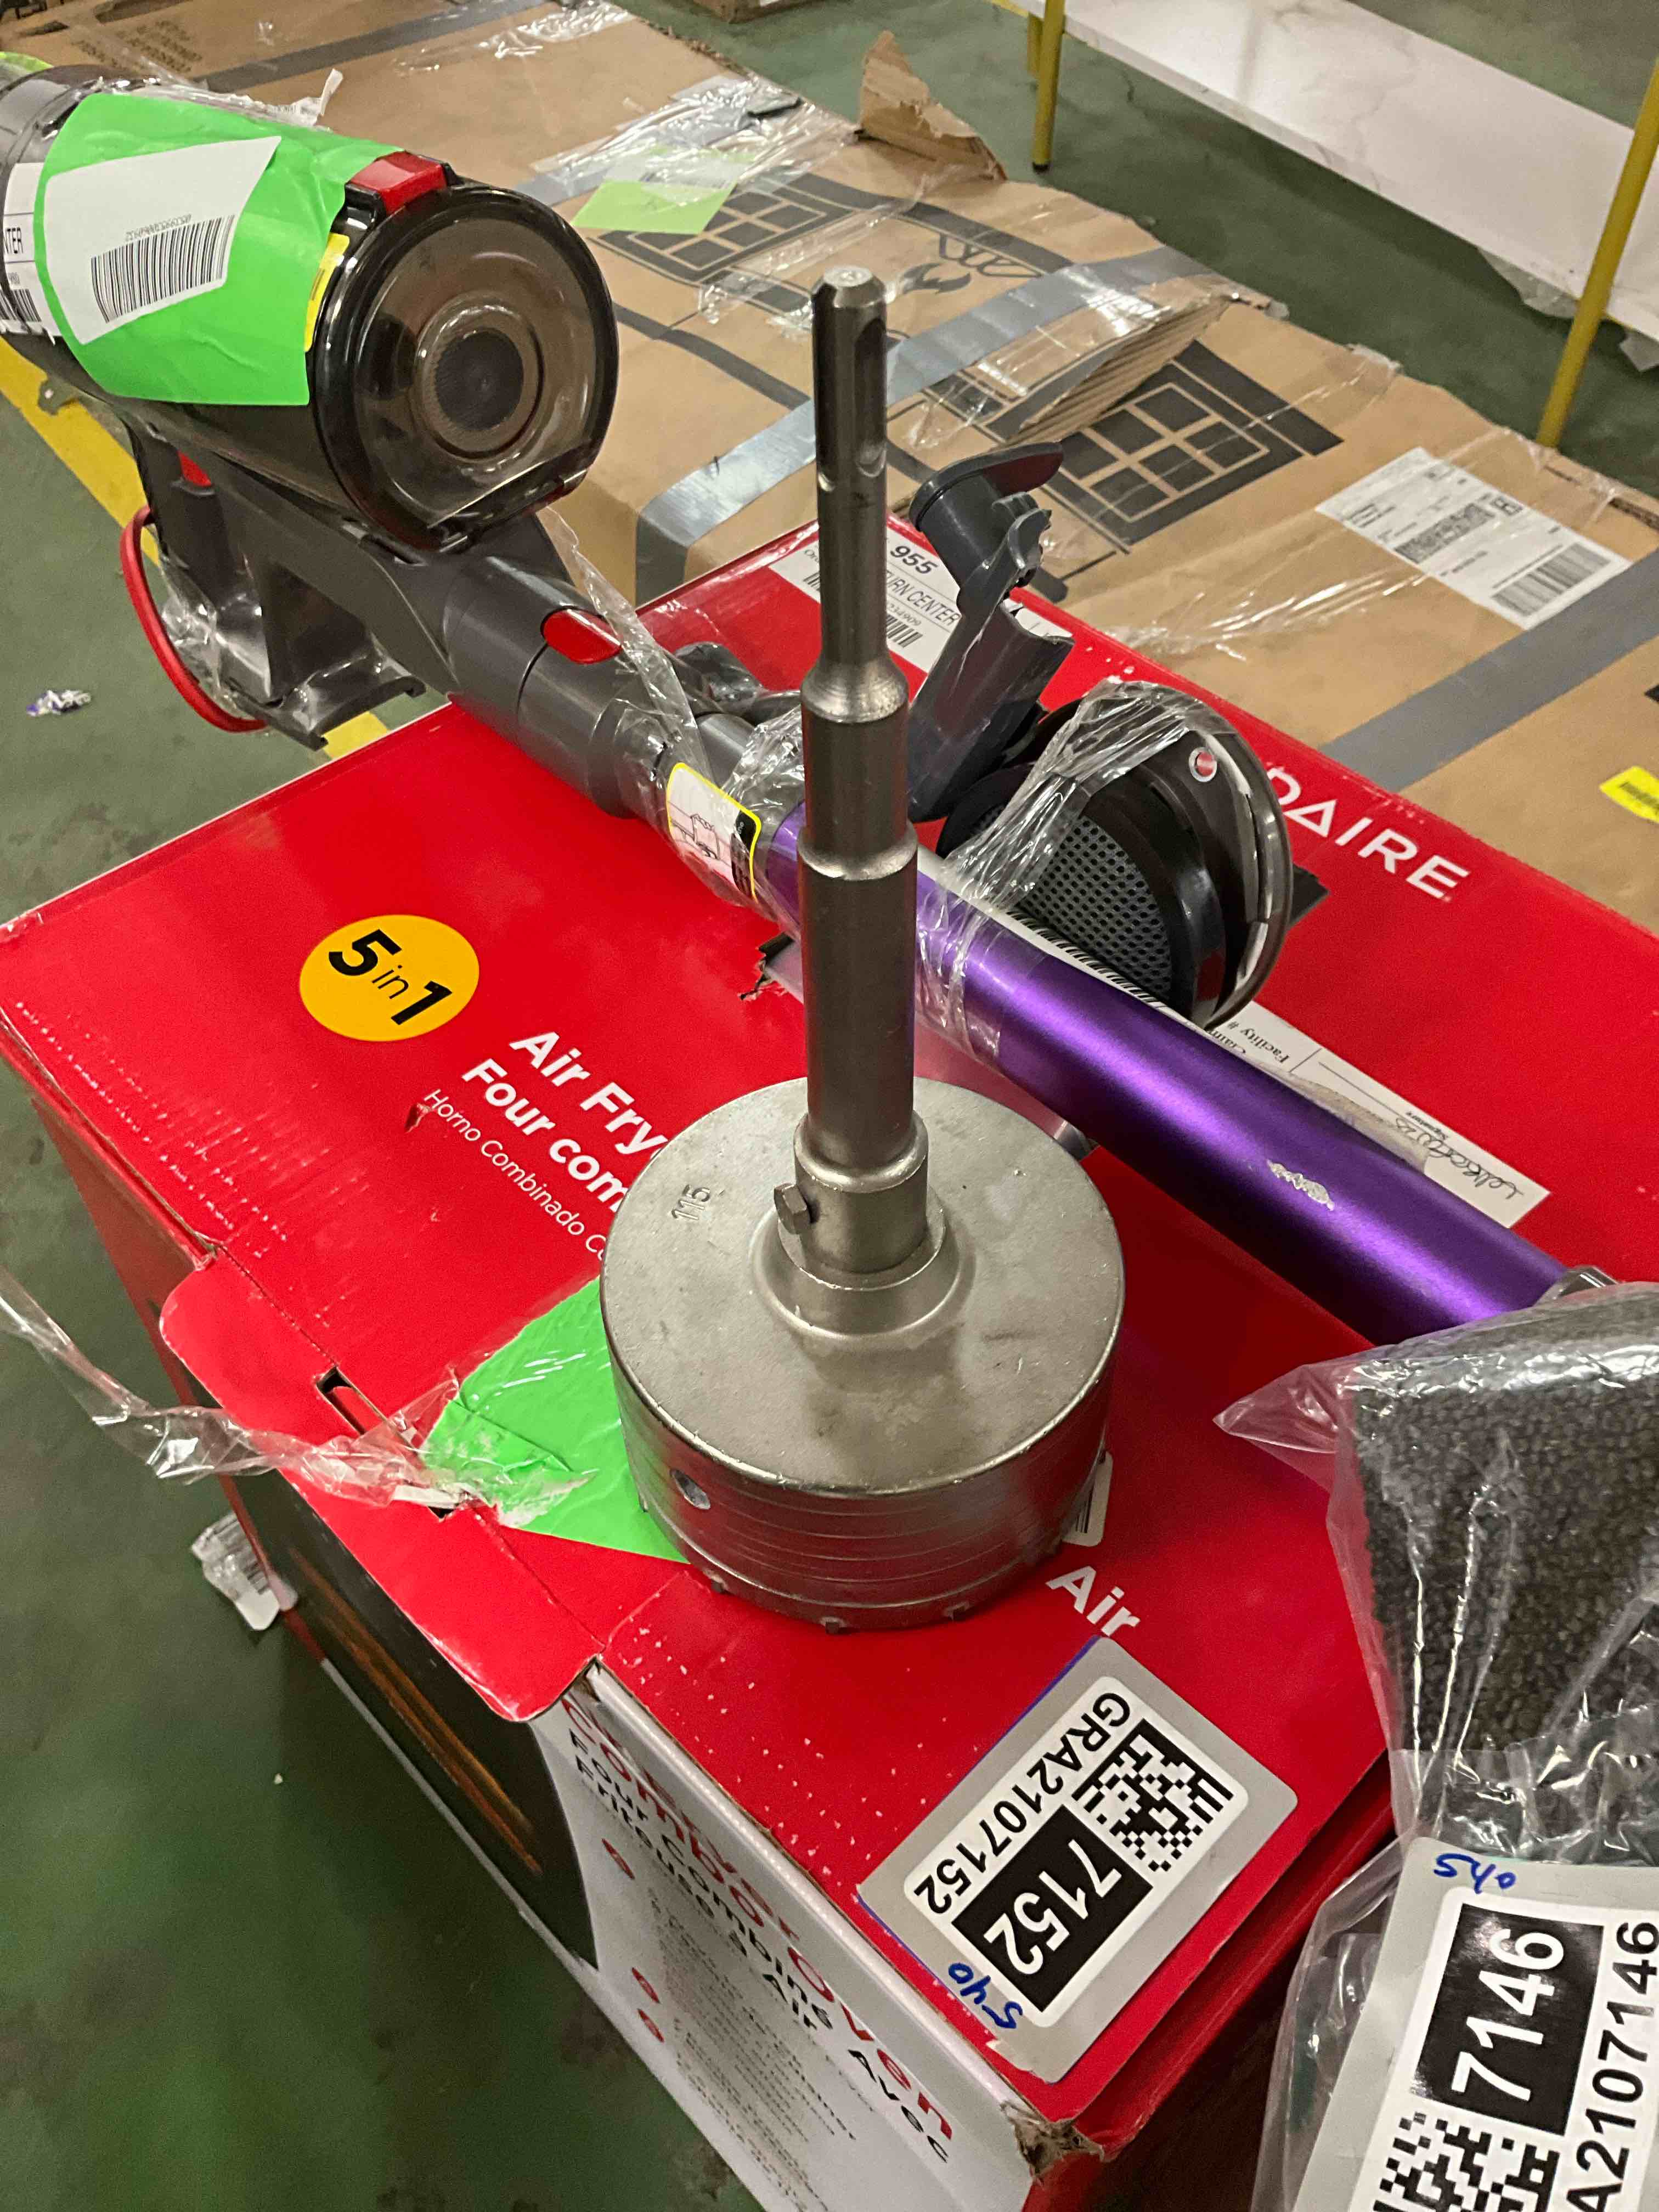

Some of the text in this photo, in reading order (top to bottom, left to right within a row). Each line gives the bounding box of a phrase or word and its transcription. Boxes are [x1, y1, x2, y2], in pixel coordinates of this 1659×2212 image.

[890, 545, 938, 574] 955
[907, 590, 961, 627] CENTER
[328, 929, 453, 1025] 5 in 1
[509, 1031, 590, 1087] Air
[1240, 1028, 1289, 1063] Facility
[461, 1058, 556, 1136] Four
[422, 1088, 481, 1142] Horno
[480, 1139, 585, 1237] Combinado
[671, 1184, 710, 1221] 115
[1046, 1565, 1142, 1637] Air
[912, 1691, 1131, 1915] GRA2107152
[983, 1838, 1122, 1975] 7152
[788, 1946, 952, 2140] Oven
[1451, 1928, 1564, 2102] 7146
